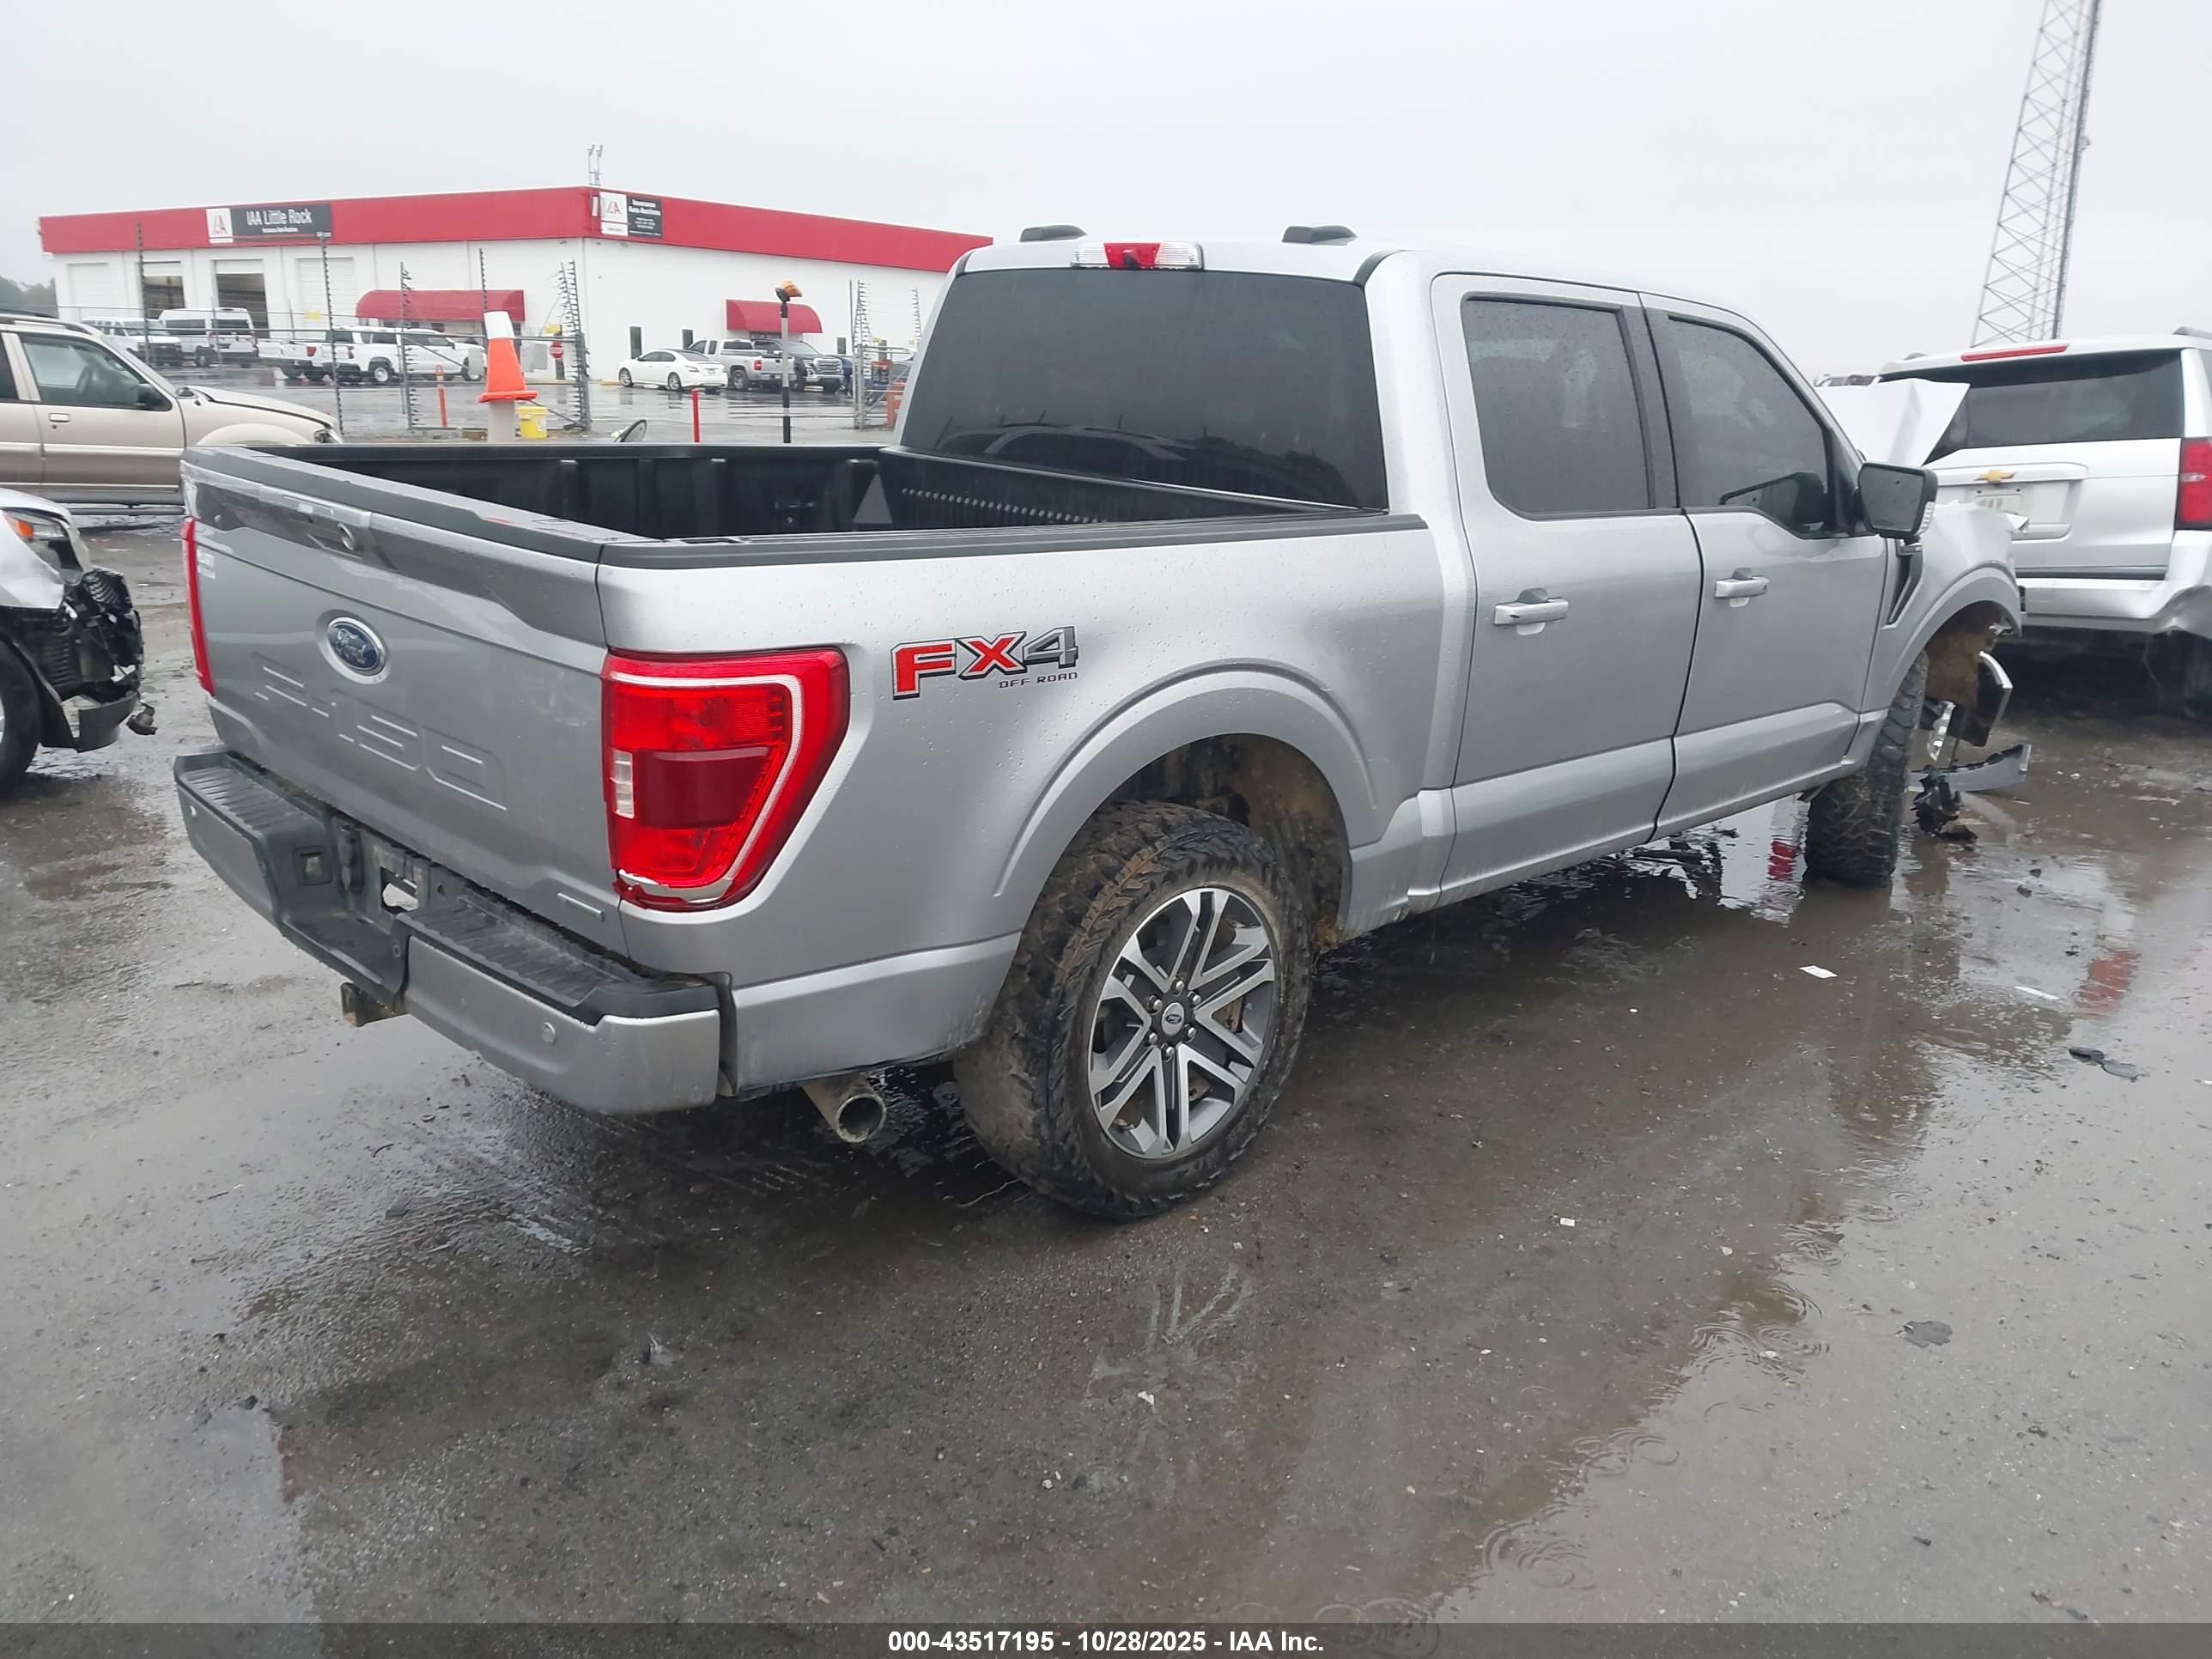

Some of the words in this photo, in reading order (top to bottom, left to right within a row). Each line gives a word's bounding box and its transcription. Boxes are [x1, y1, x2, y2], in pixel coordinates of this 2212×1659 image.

[289, 208, 313, 224] Rock
[890, 626, 1079, 701] FX4
[999, 677, 1031, 690] OFF
[1036, 672, 1079, 684] ROAD
[250, 651, 510, 811] F-150
